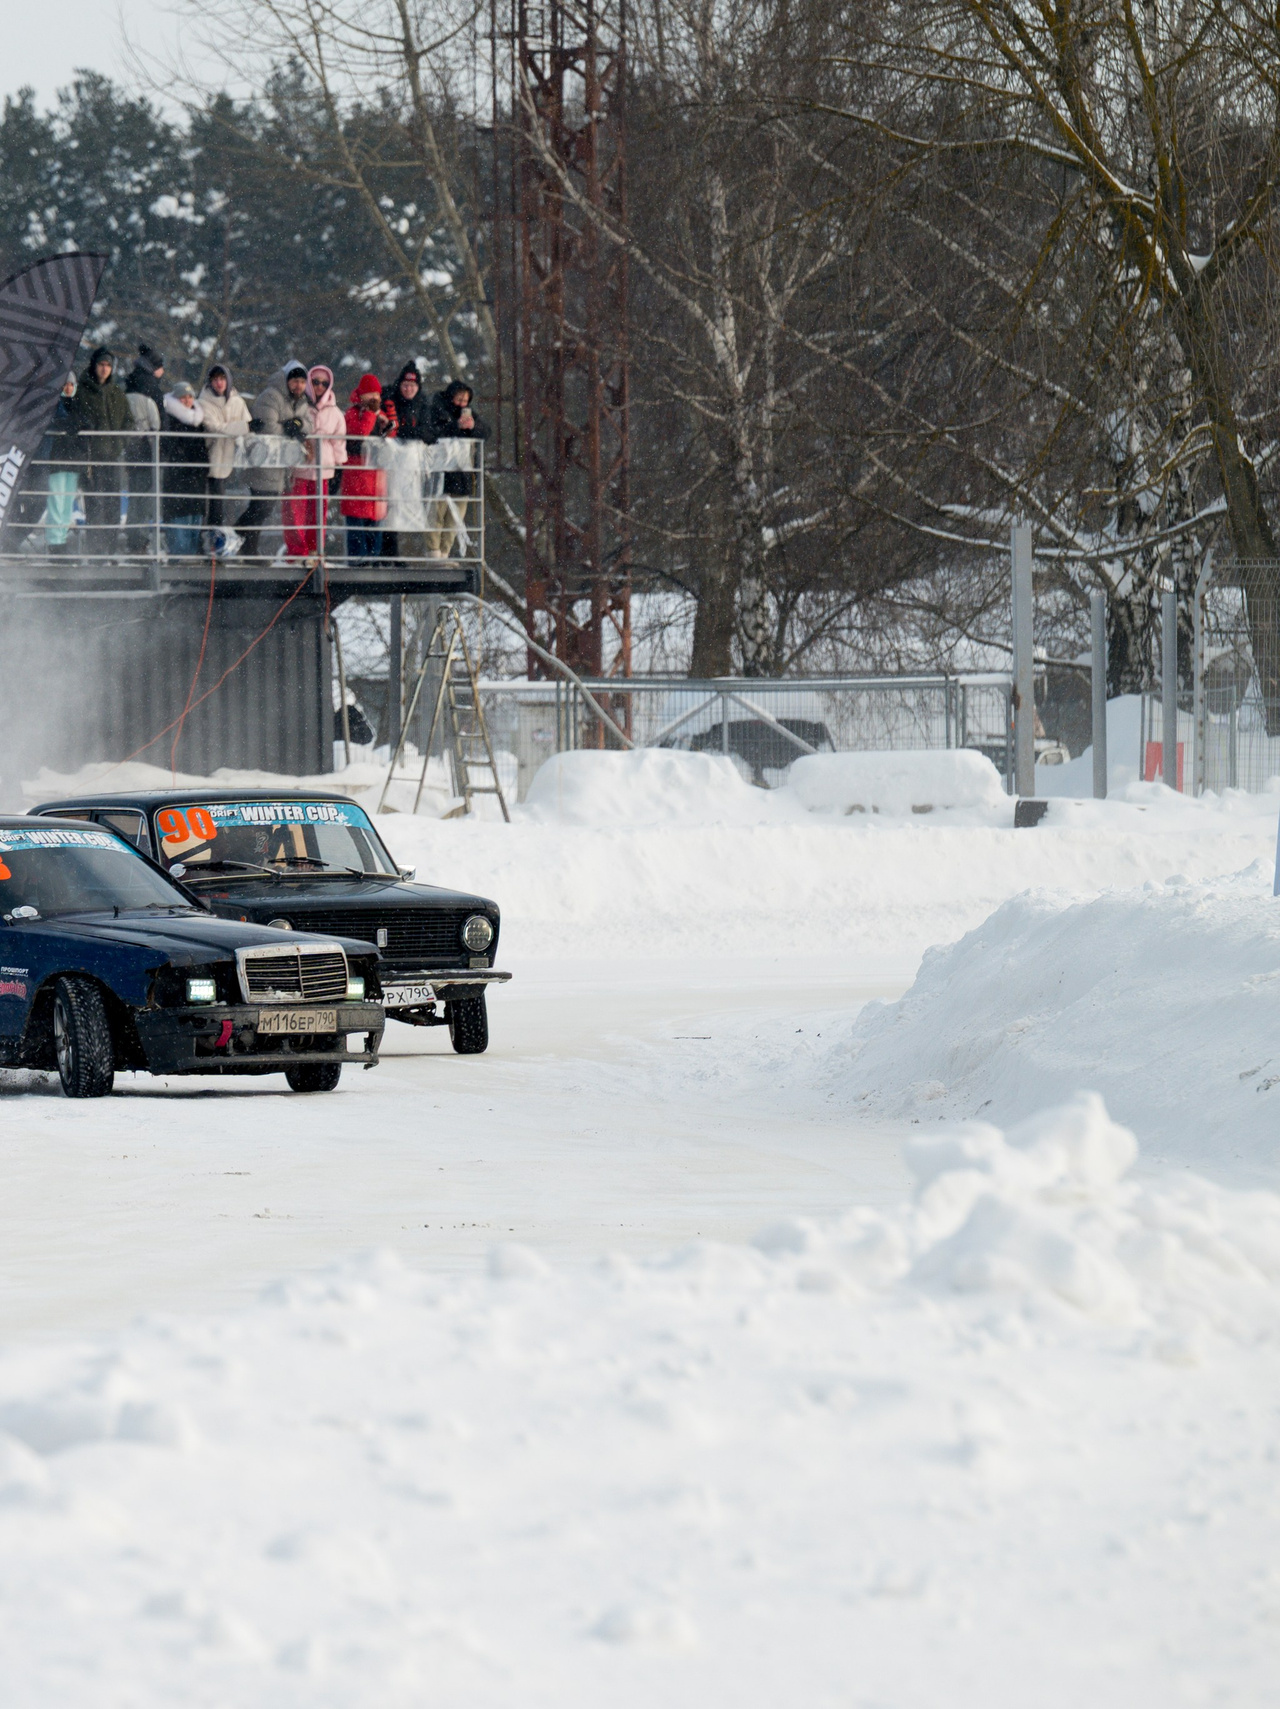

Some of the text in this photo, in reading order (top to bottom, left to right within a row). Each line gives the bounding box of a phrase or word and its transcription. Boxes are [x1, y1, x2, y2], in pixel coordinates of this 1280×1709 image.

[210, 806, 339, 821] DRIFT WINTER CUP
[158, 807, 218, 844] 90
[0, 831, 112, 847] DRIFT WINTER CUP
[407, 987, 430, 998] 790
[317, 1011, 334, 1025] 790
